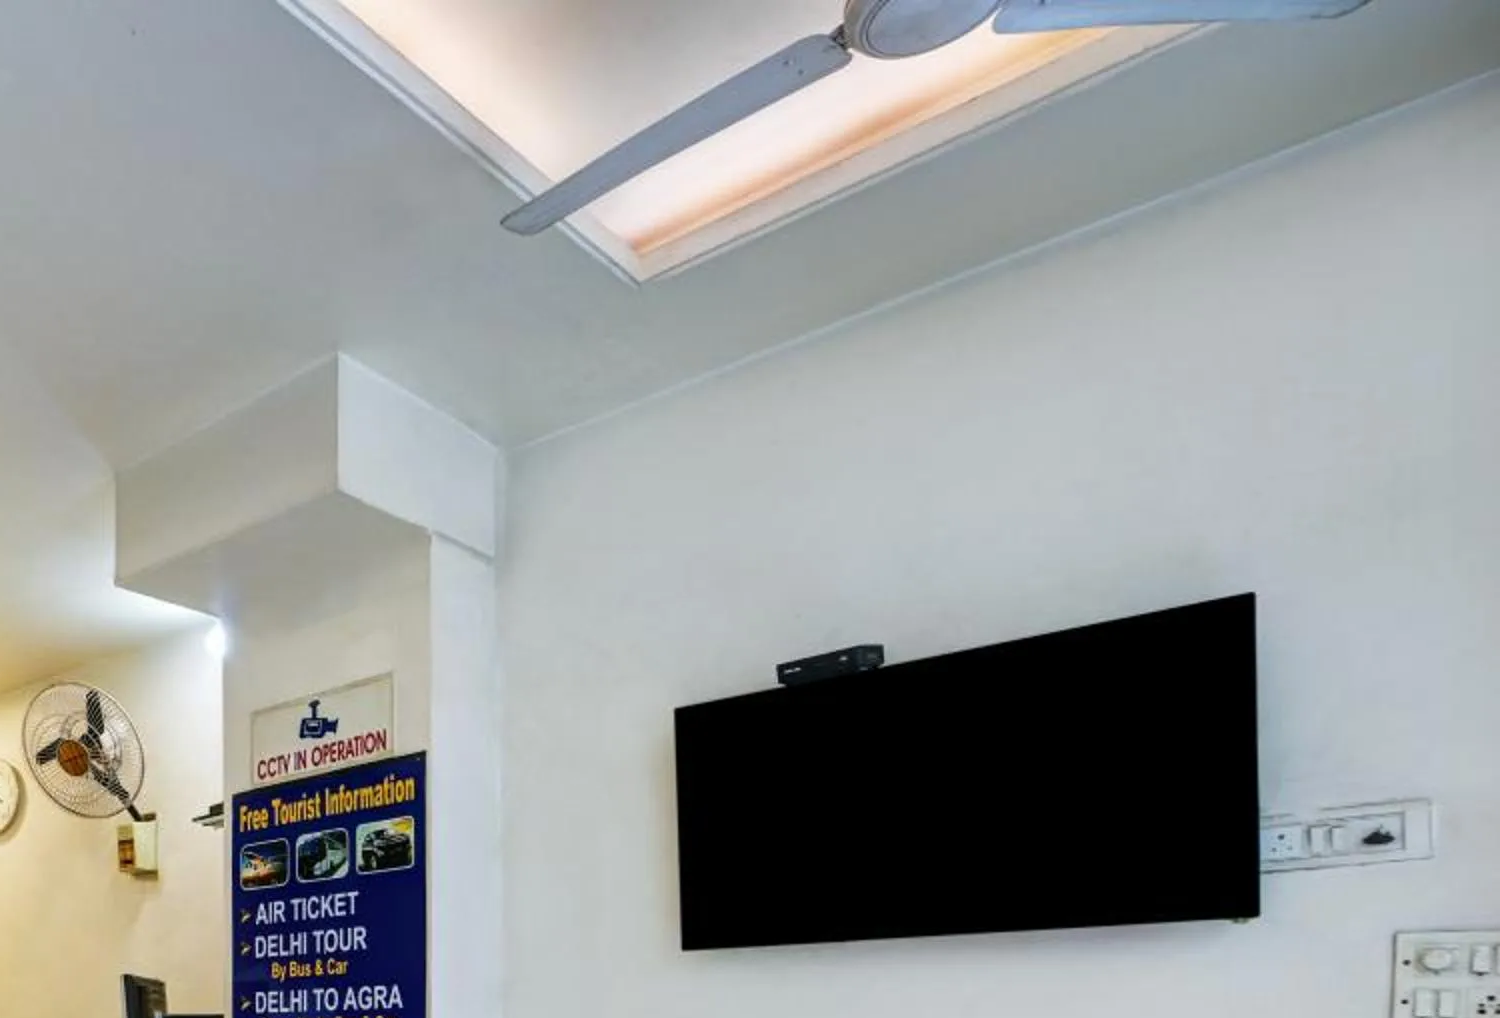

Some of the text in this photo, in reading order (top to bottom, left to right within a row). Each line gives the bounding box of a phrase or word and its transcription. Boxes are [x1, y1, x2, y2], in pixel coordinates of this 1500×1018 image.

[257, 729, 387, 780] CCTV IN OPERATION
[240, 774, 415, 833] Free Tourist Information
[256, 891, 359, 925] AIR TICKET
[255, 926, 367, 959] DELHI TOUR
[271, 958, 348, 982] By Bus & Car
[255, 984, 403, 1014] DELHI TO AGRA
